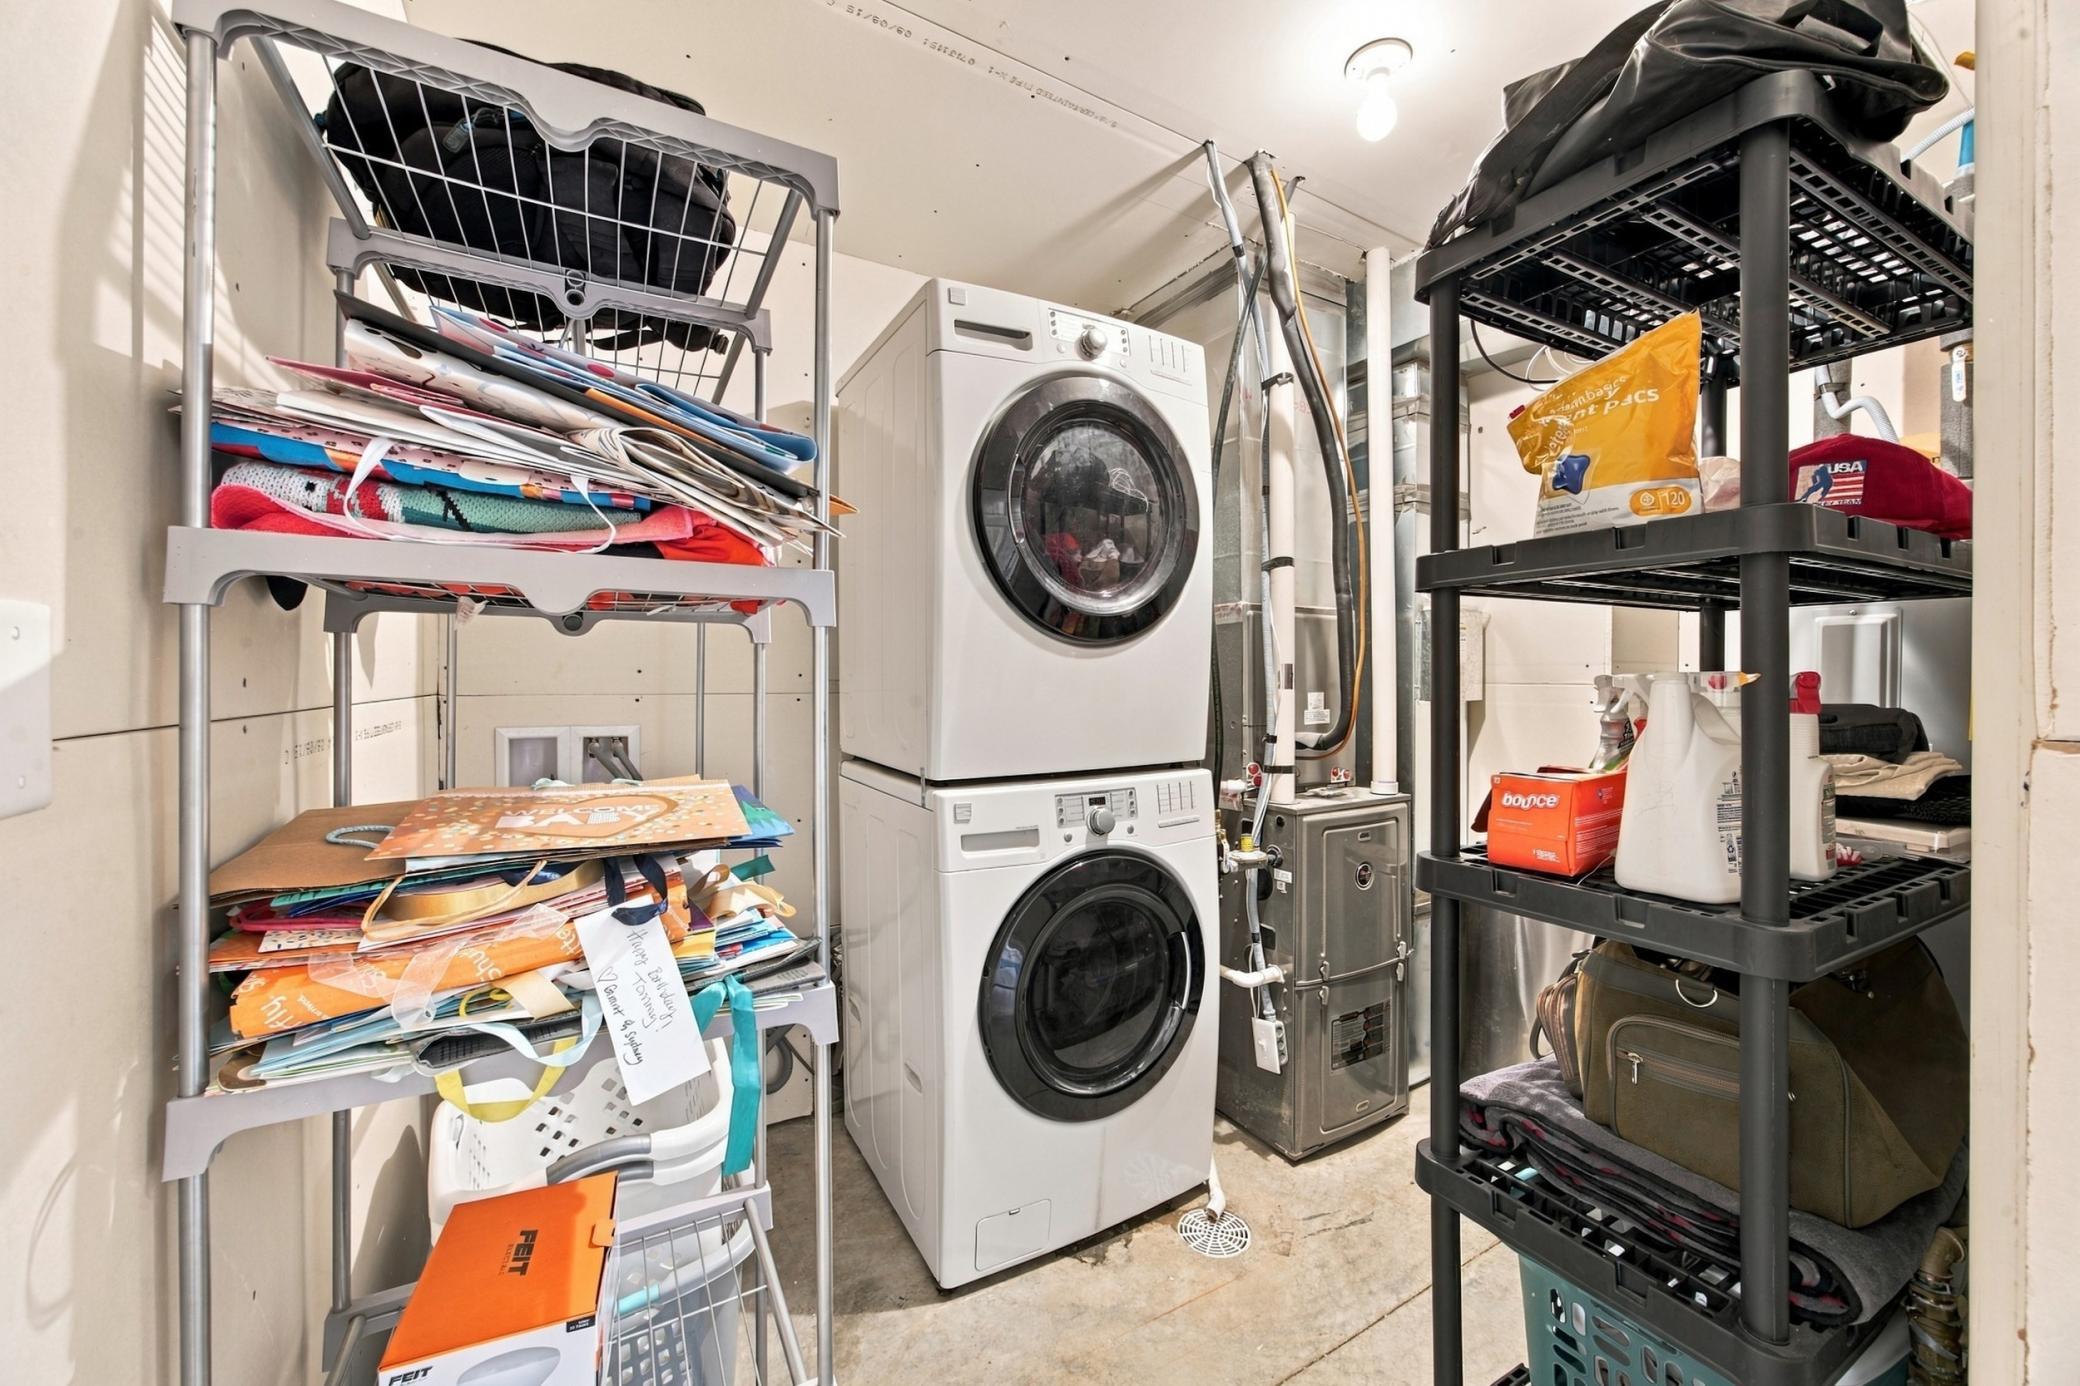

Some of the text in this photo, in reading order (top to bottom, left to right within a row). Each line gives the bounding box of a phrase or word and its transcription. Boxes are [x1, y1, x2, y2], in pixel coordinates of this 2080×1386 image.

[1827, 460, 1864, 475] USA
[1663, 490, 1686, 506] 120
[505, 804, 660, 817] WELCOME
[1502, 791, 1560, 811] bounce
[495, 810, 651, 829] BABY
[626, 928, 650, 967] Happy
[603, 984, 625, 1017] Grant
[623, 1031, 644, 1066] Sydney
[508, 1229, 539, 1277] FEIT
[388, 1366, 434, 1386] FEIT
